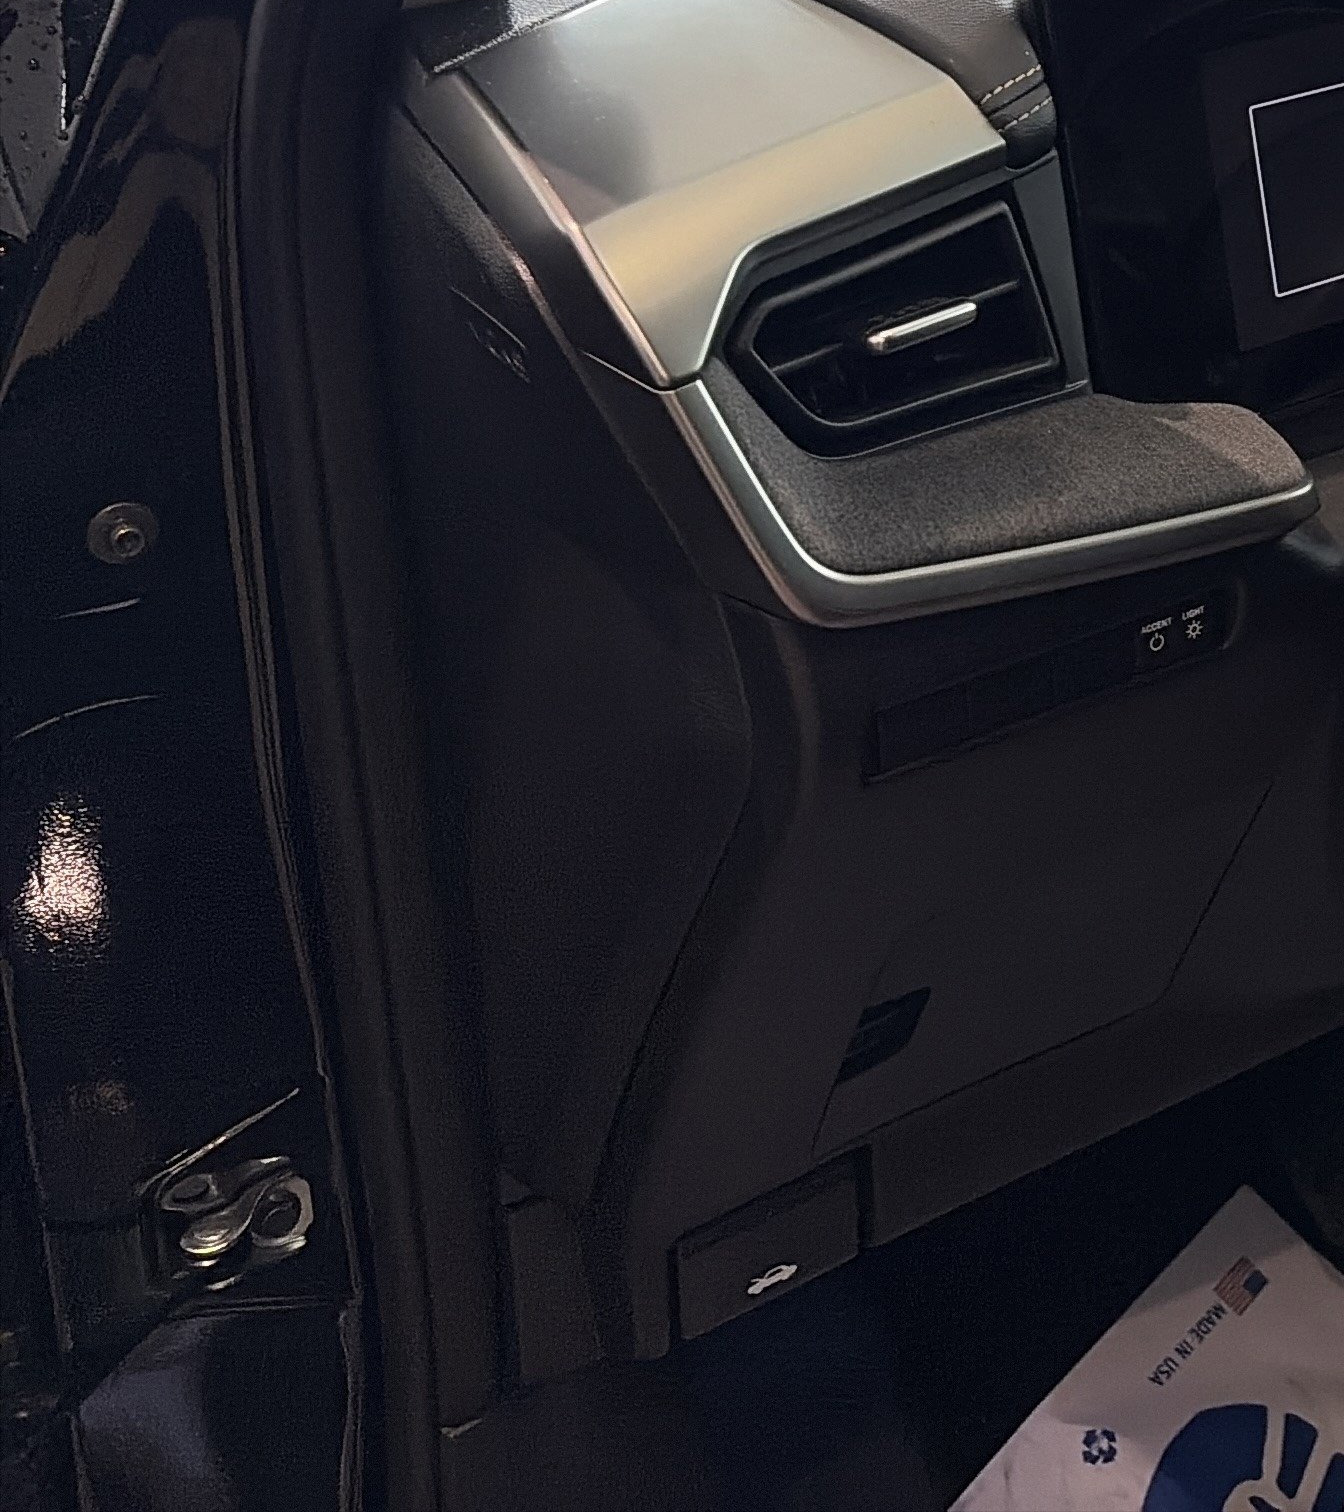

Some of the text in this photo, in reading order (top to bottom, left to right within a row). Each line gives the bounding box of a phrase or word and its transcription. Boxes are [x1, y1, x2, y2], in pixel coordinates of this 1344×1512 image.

[1182, 605, 1204, 621] LIGHT
[1141, 616, 1172, 634] ACCENT
[1147, 1302, 1228, 1386] MADE IN USA
